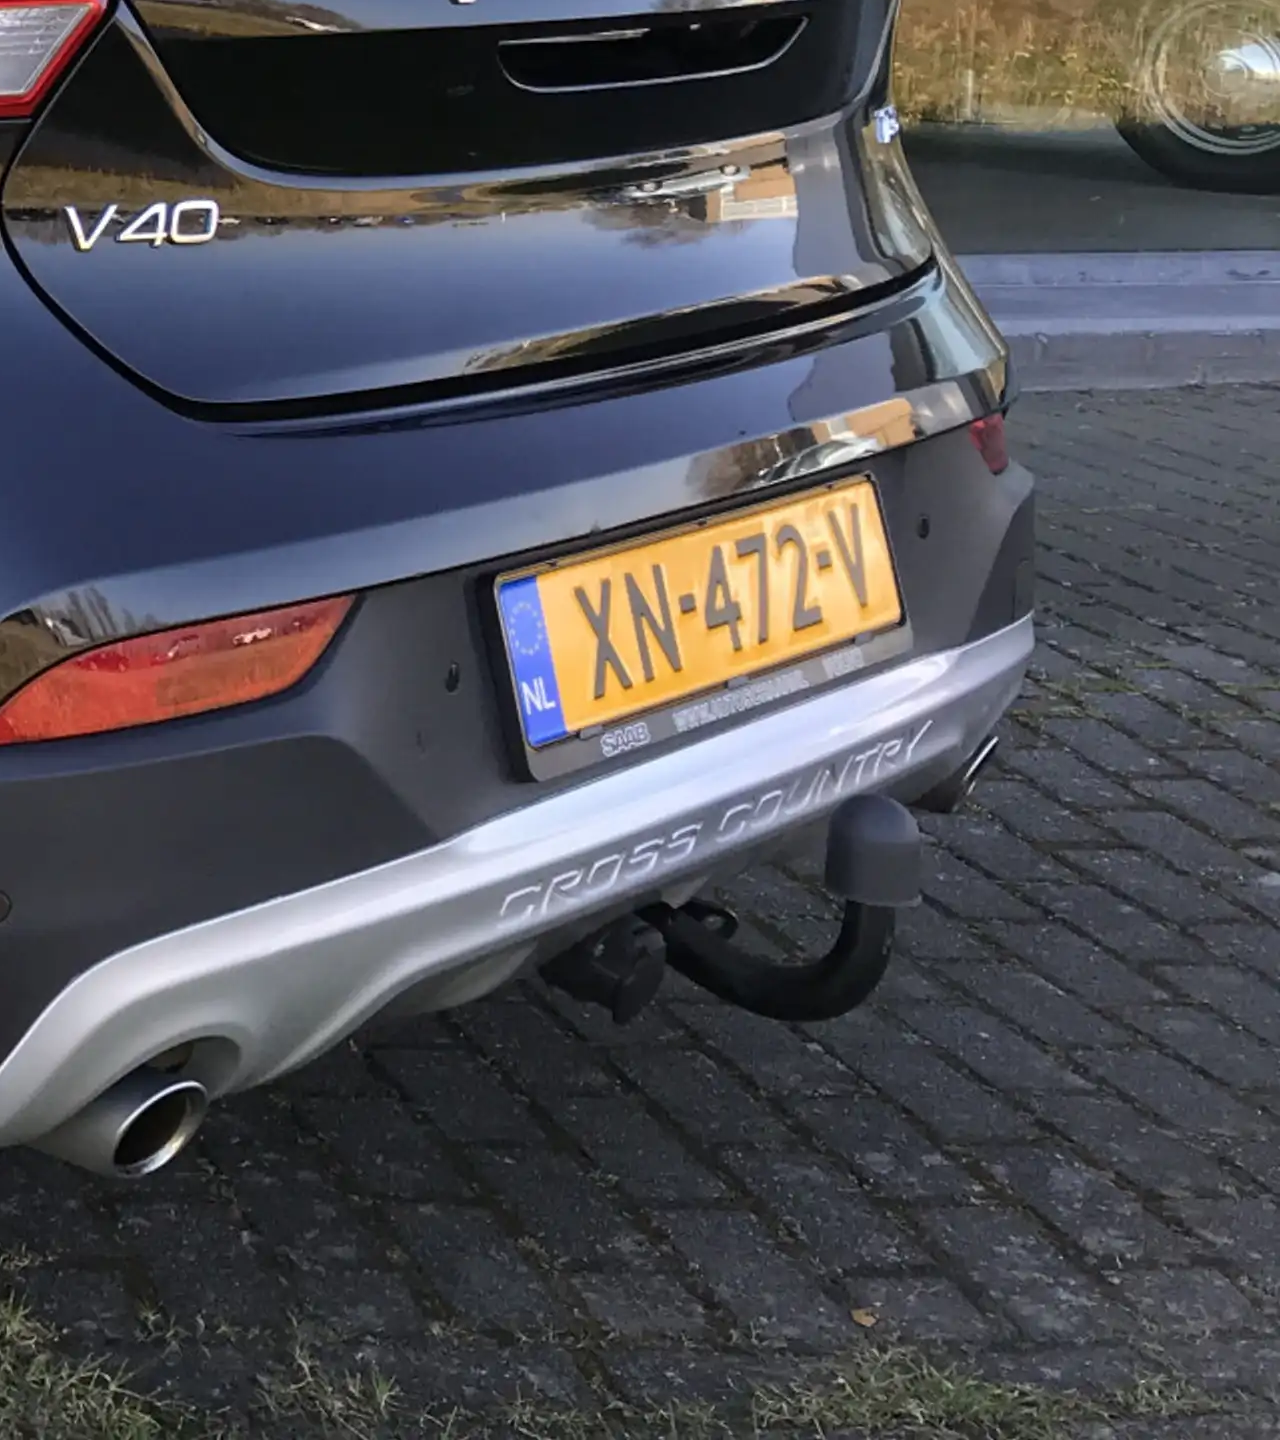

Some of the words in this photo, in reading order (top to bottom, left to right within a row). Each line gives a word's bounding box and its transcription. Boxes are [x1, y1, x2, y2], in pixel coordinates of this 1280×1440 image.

[64, 199, 220, 251] V40
[574, 503, 868, 700] XN-472-V
[520, 679, 557, 716] NL
[500, 823, 701, 921] CROSS
[716, 719, 934, 835] COUNTRY
